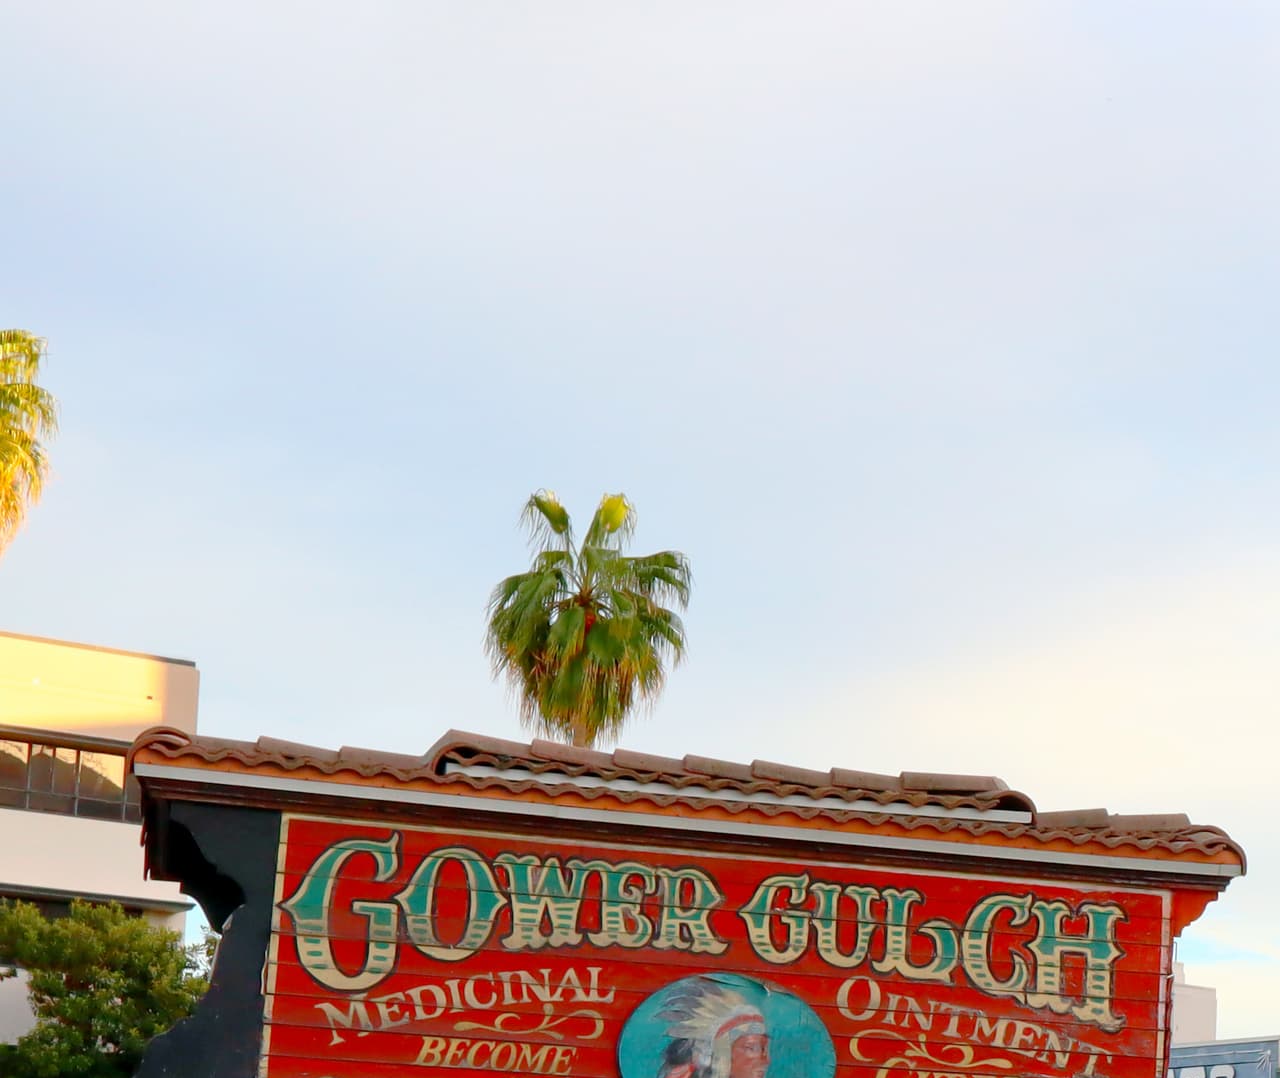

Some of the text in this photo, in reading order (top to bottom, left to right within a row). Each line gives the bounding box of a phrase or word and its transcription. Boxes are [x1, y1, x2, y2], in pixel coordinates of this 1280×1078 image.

[280, 830, 1130, 1034] GOWER GULCH
[314, 966, 616, 1047] MEDICINAL
[836, 974, 1113, 1078] OINTMENT
[413, 1035, 578, 1076] BECOME
